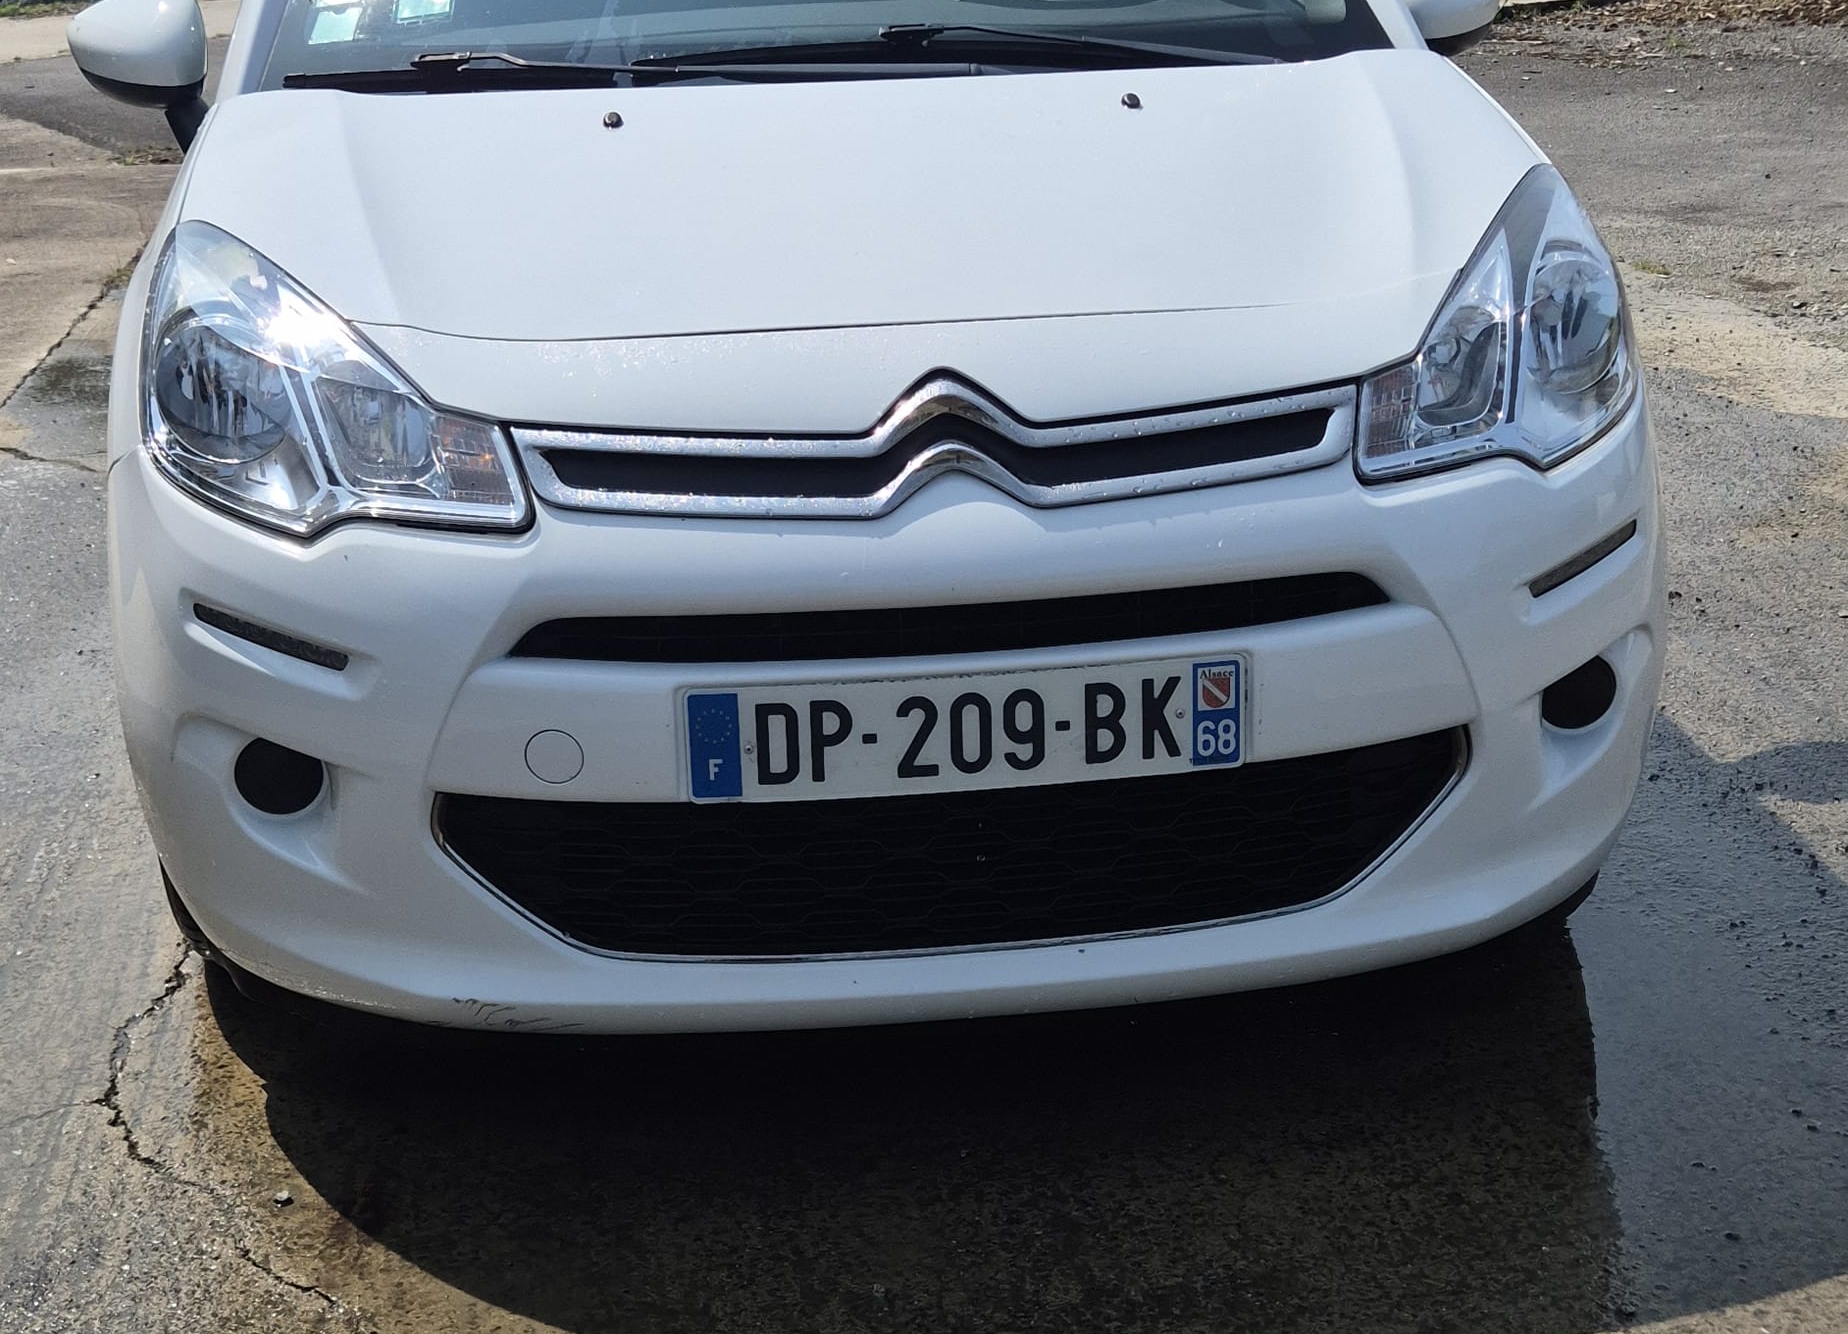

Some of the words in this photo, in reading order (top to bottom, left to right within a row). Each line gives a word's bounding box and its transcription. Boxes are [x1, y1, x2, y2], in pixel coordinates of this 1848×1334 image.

[755, 676, 1182, 786] DP-209-BK
[1197, 718, 1236, 757] 68
[708, 758, 723, 781] F
